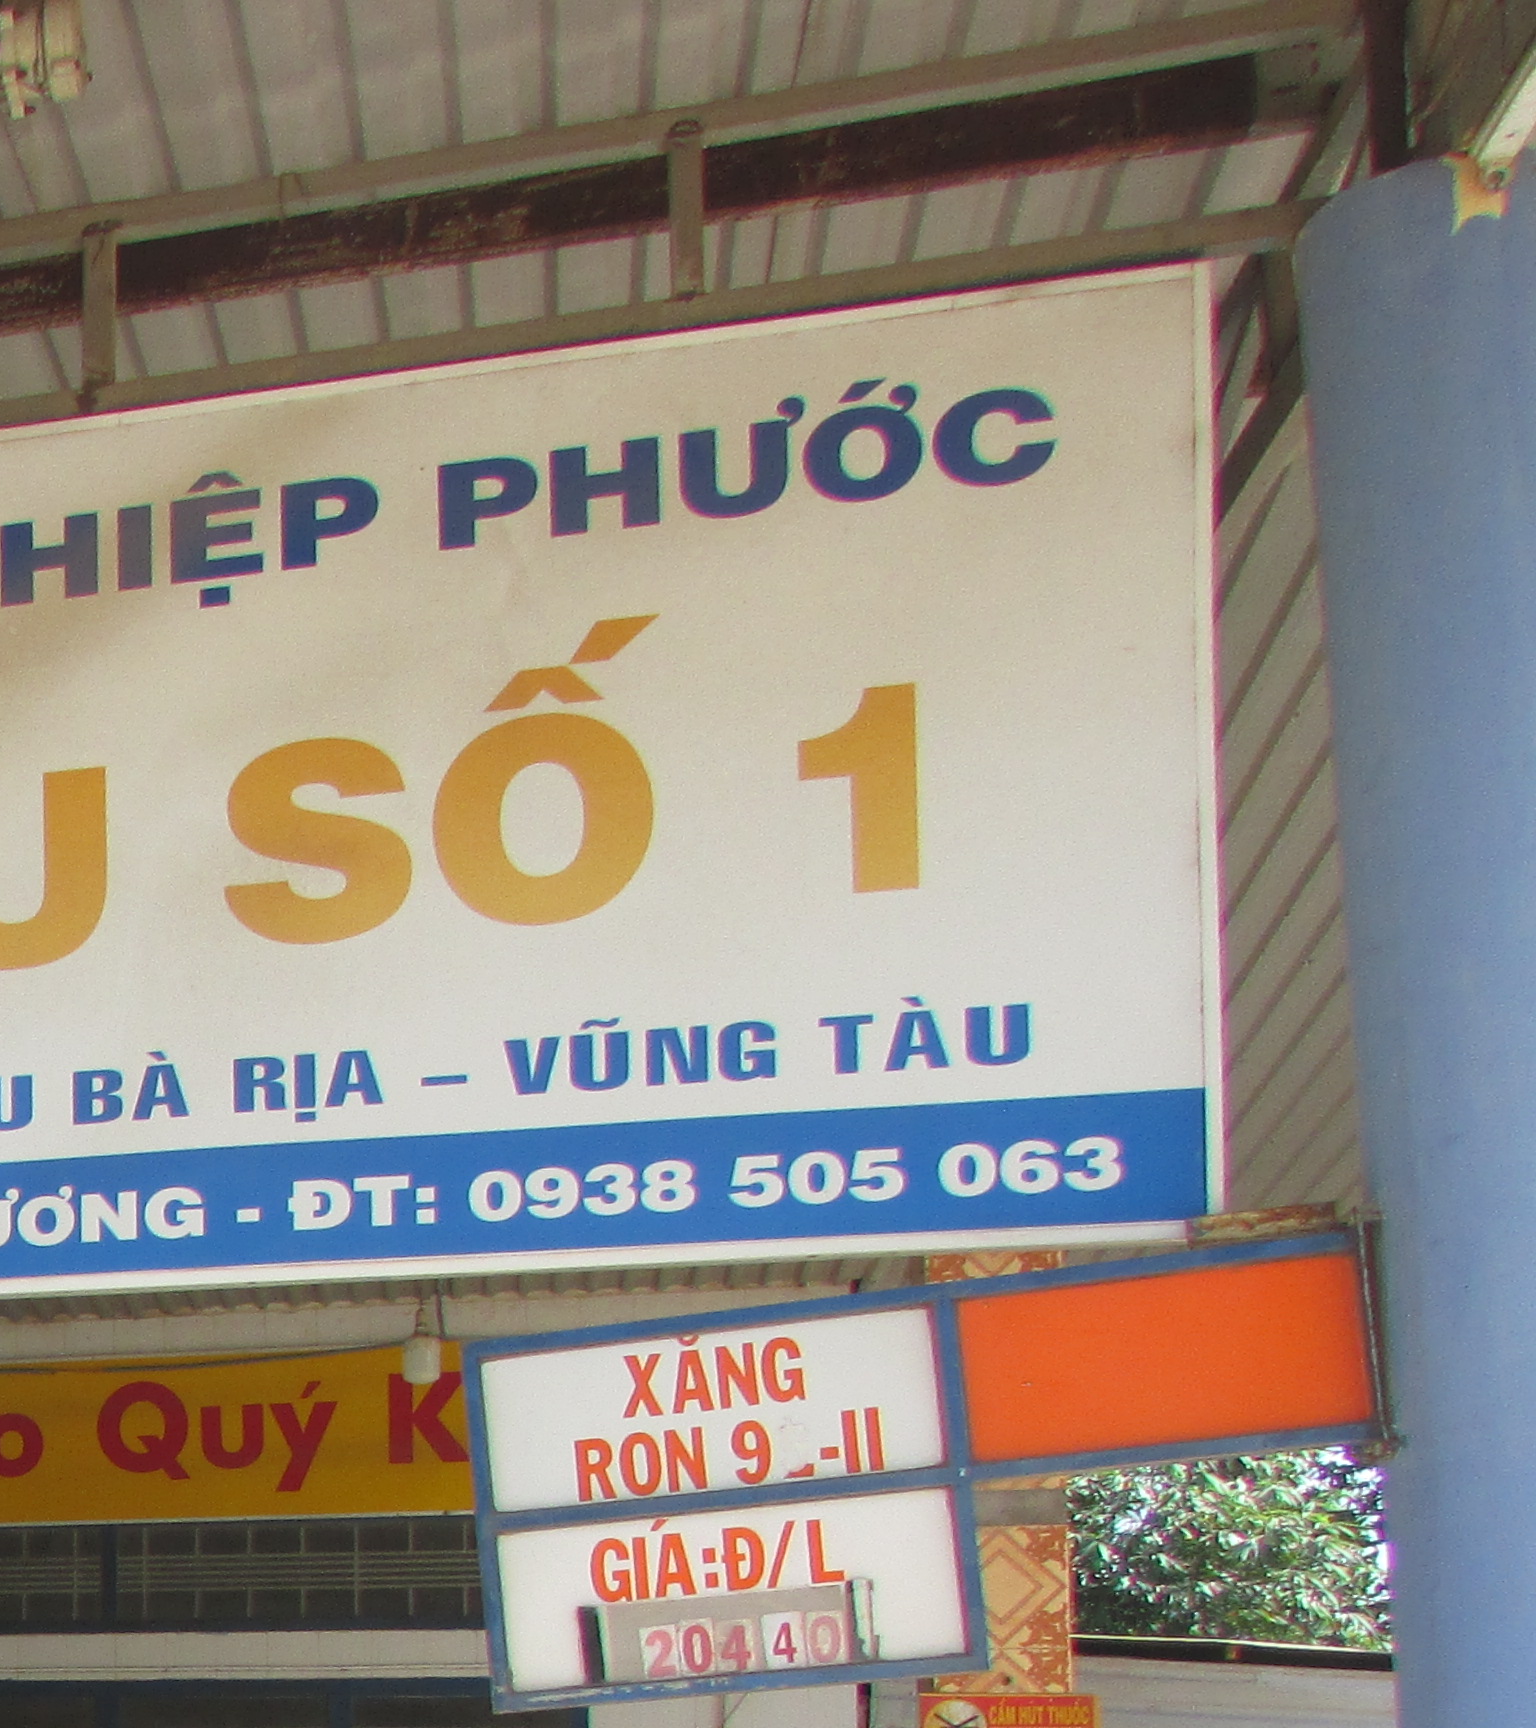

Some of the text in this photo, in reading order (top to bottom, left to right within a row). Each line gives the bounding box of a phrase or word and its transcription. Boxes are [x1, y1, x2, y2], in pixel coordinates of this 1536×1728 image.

[1, 471, 379, 605] HIỆP
[439, 378, 1057, 548] PHƯỚC
[226, 614, 659, 943] SỐ
[800, 682, 919, 891] 1
[74, 1050, 188, 1124] BÀ
[235, 1051, 382, 1122] RỊA
[505, 1018, 775, 1094] VŨNG
[821, 996, 1029, 1073] TÀU
[290, 1174, 436, 1230] ĐT:
[471, 1160, 696, 1221] 0938
[732, 1148, 906, 1206] 505
[942, 1137, 1123, 1196] 063
[622, 1334, 806, 1418] XĂNG
[97, 1380, 338, 1492] Quý
[574, 1407, 884, 1501] RON 9-II
[589, 1518, 845, 1602] GIÁ:Đ/L
